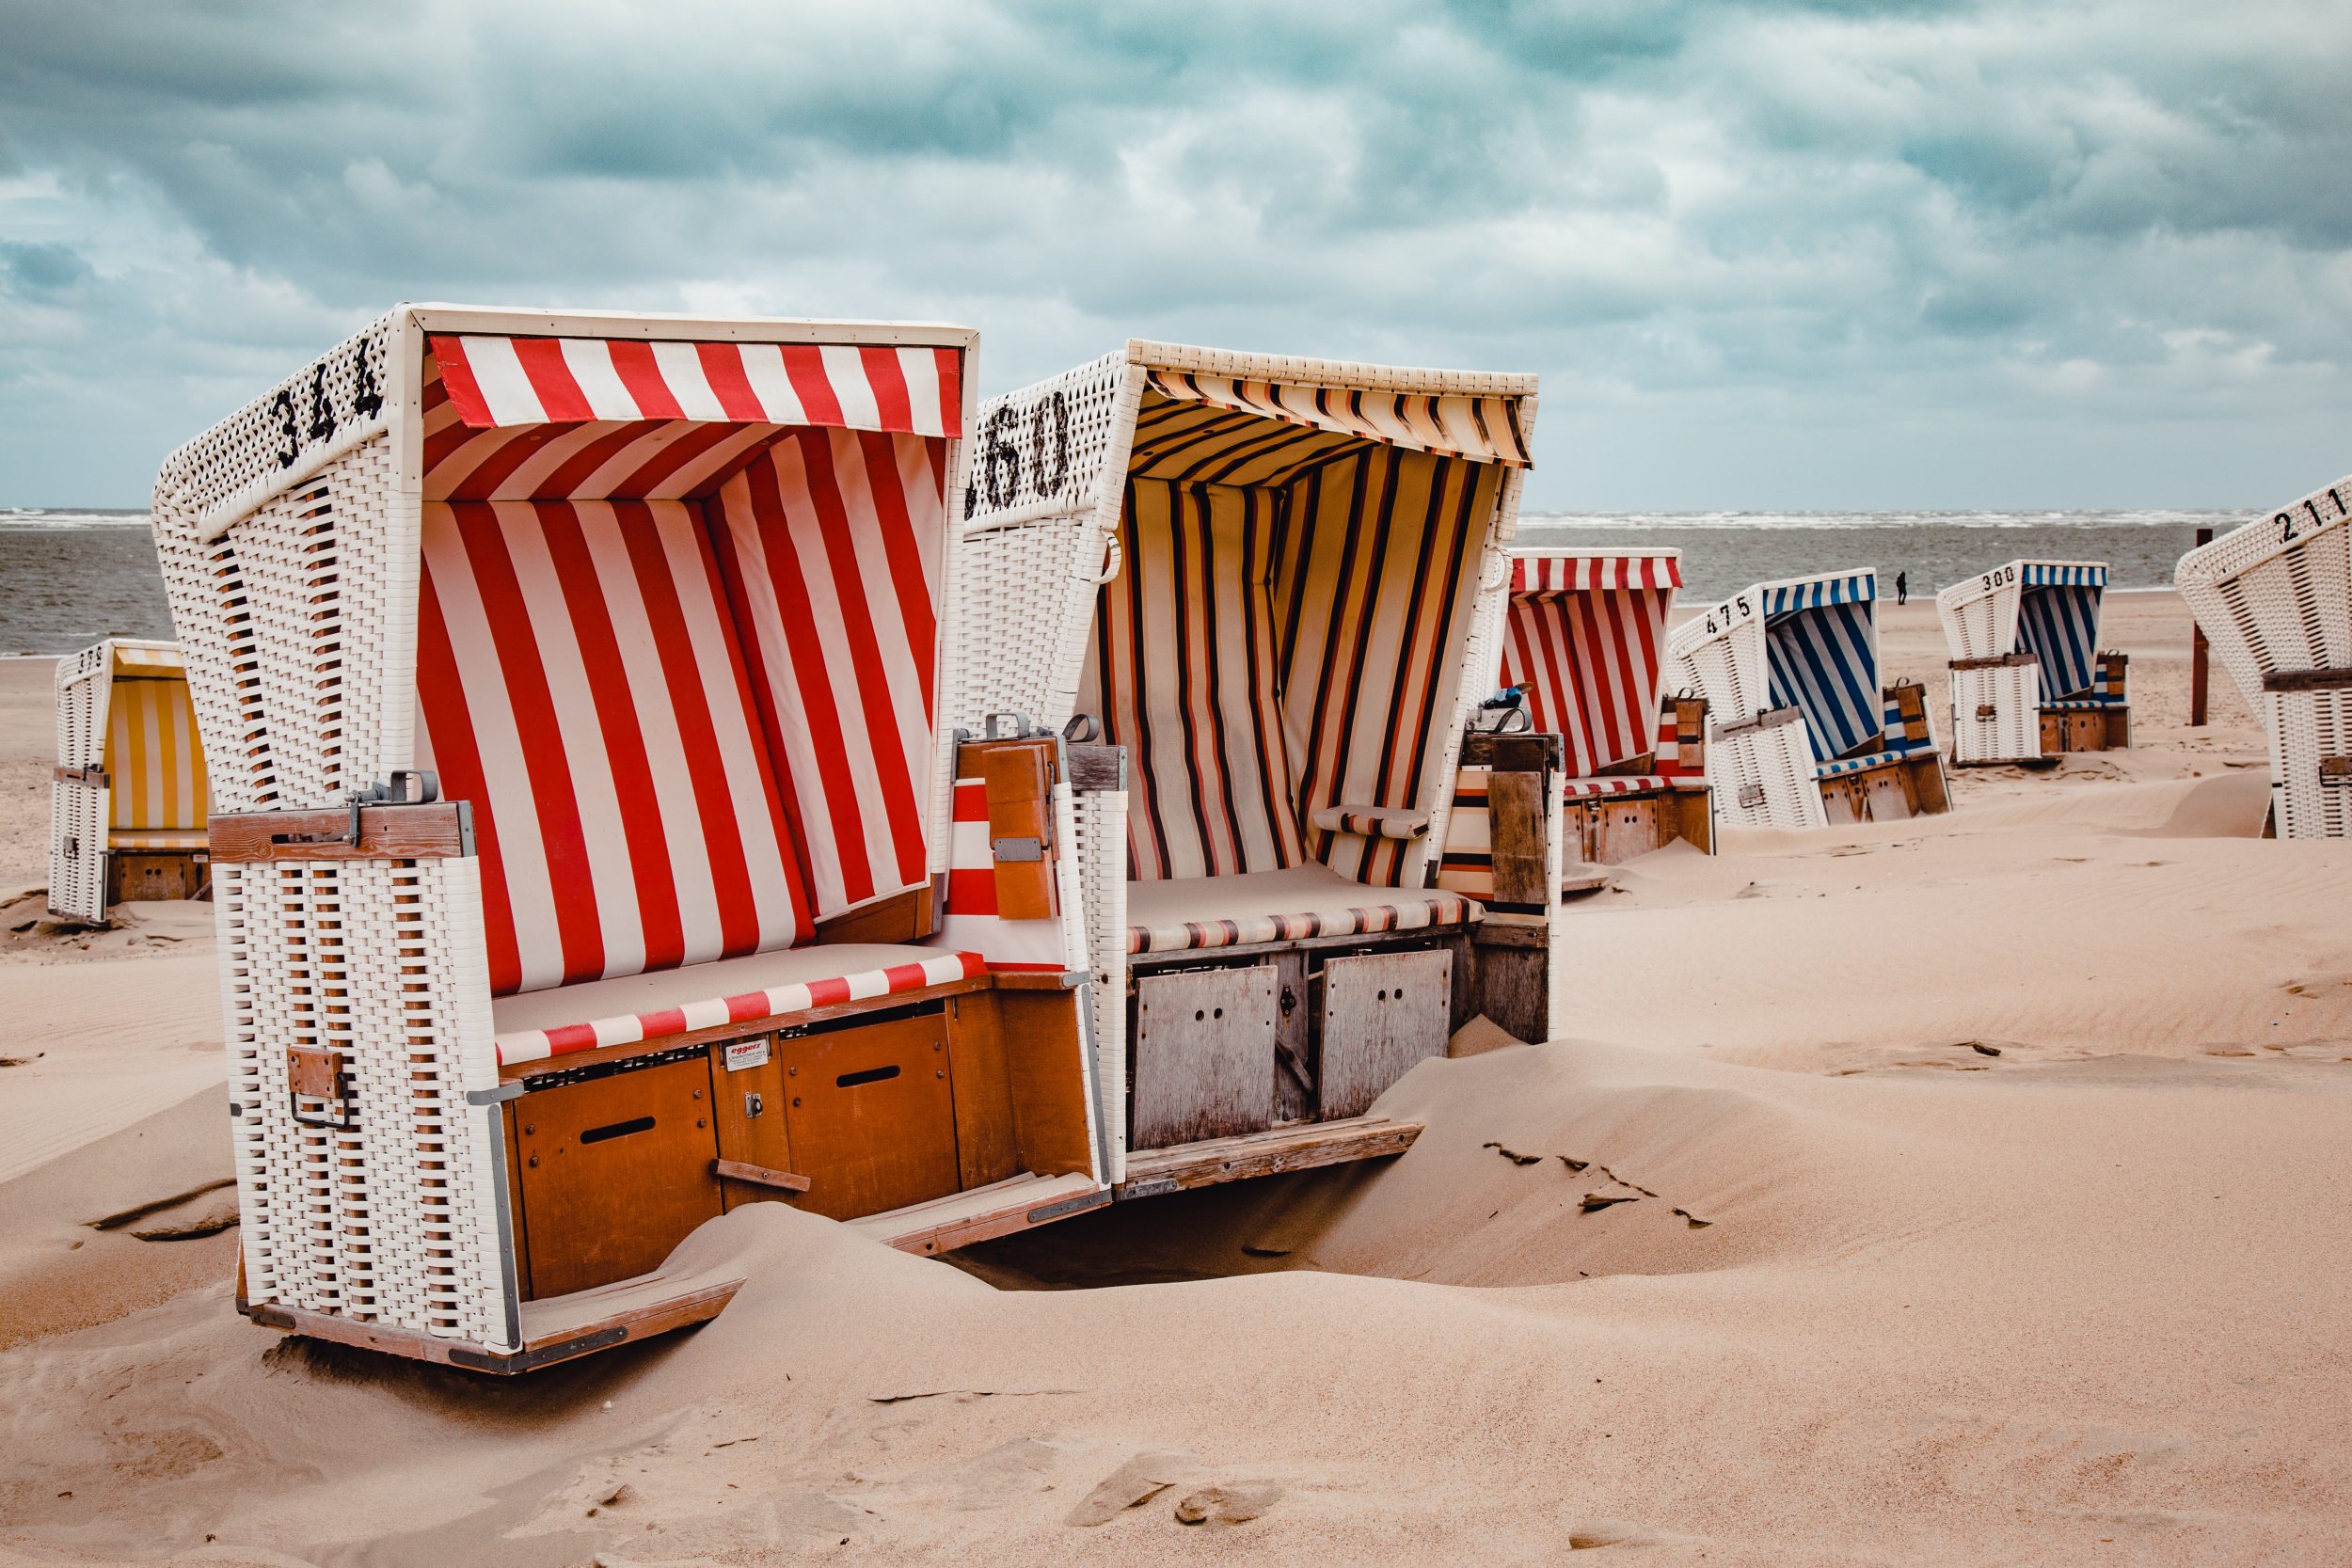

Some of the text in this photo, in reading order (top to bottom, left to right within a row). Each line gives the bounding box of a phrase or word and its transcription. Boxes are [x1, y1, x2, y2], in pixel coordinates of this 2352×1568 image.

[271, 338, 384, 469] 344
[964, 391, 1069, 521] 60
[2275, 488, 2346, 543] 211
[1983, 566, 2014, 592] 300
[1707, 595, 1751, 634] 475
[731, 1043, 761, 1054] eggers
